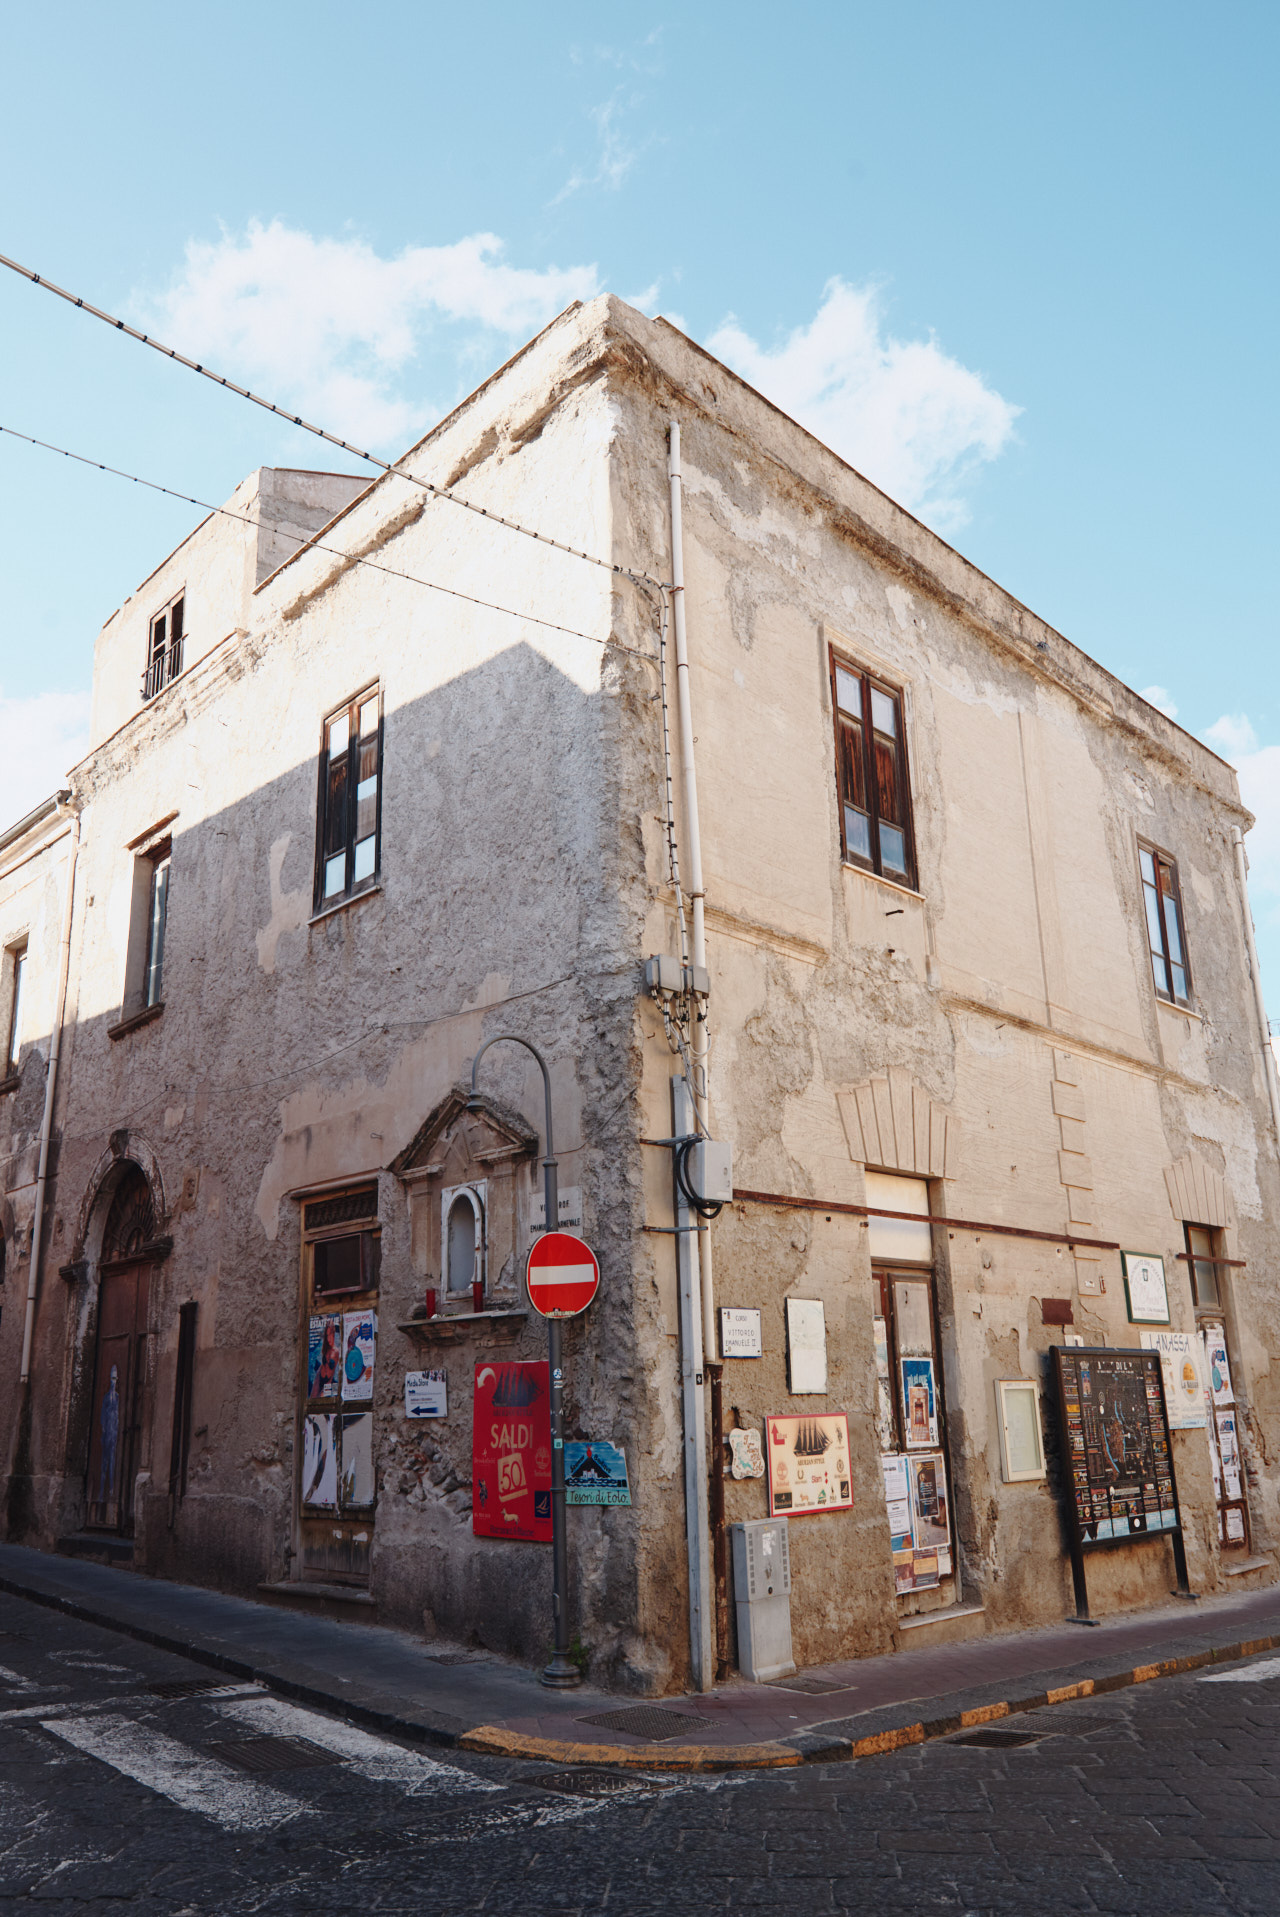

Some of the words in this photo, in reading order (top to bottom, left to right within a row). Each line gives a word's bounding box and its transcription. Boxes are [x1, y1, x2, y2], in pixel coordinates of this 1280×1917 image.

[727, 1329, 755, 1337] VITTORIO
[725, 1339, 751, 1347] EMANUELE
[490, 1423, 534, 1449] SALDI
[501, 1460, 523, 1491] 50
[570, 1490, 594, 1504] Tesori
[595, 1489, 607, 1503] di
